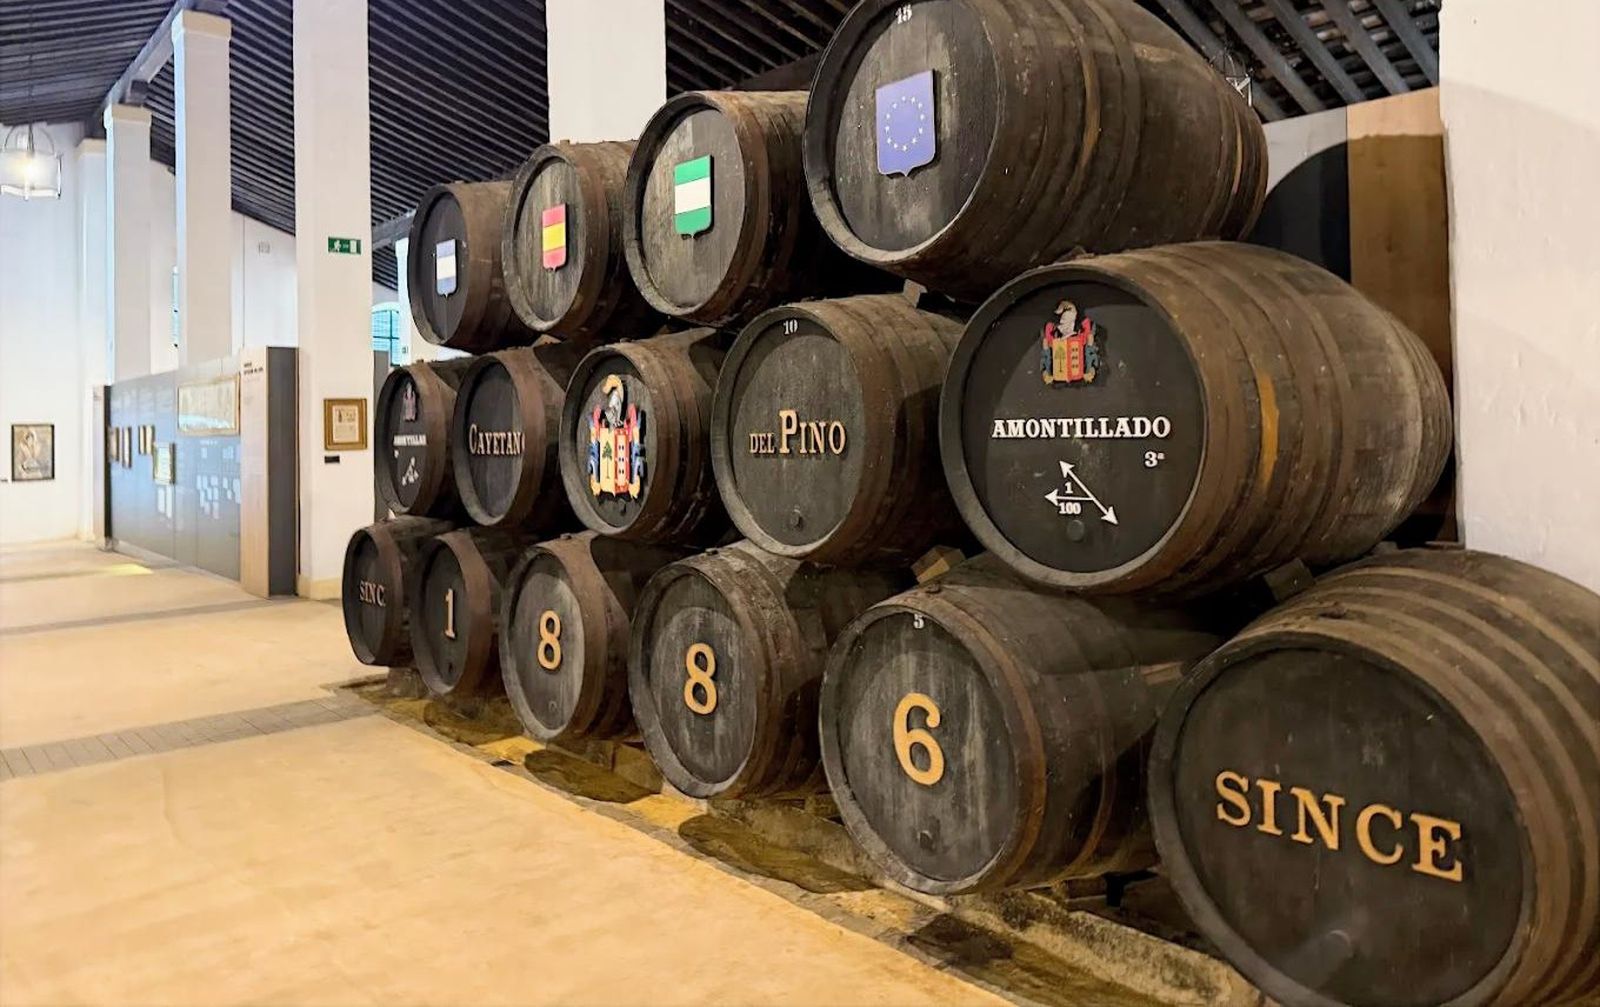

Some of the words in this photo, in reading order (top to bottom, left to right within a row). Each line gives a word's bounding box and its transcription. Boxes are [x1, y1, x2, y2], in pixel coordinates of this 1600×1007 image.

[783, 319, 798, 335] 10
[749, 432, 775, 454] DEL
[779, 409, 846, 455] PINO
[992, 417, 1171, 438] AMONTILLADO
[1059, 502, 1081, 515] 100
[1064, 482, 1074, 494] 1
[444, 588, 456, 639] 1
[913, 613, 925, 630] 5
[537, 610, 562, 670] 8
[684, 642, 718, 715] 8
[893, 692, 945, 786] 6
[1215, 770, 1463, 882] SINCE
